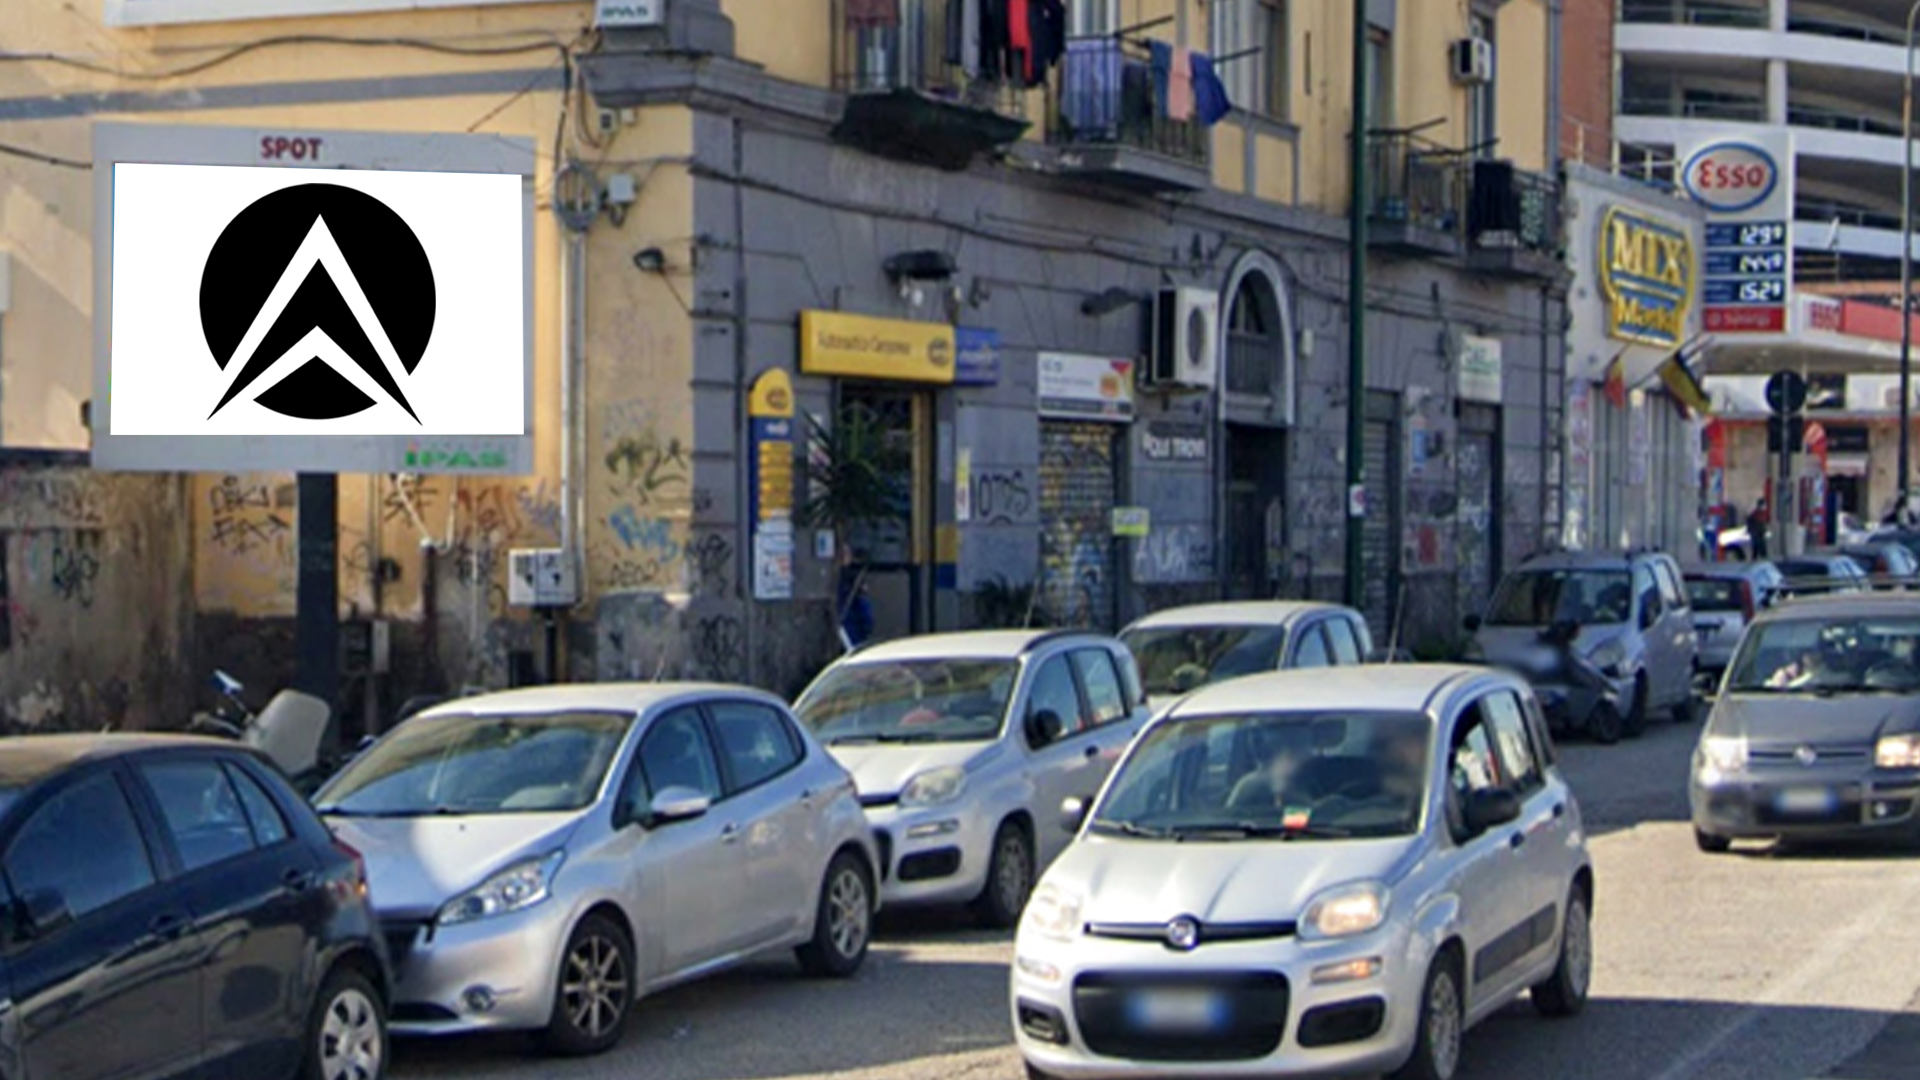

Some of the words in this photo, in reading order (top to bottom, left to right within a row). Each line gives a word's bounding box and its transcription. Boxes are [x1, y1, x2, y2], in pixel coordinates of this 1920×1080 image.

[261, 136, 322, 160] SPOT
[1699, 159, 1764, 189] Esso
[1612, 219, 1688, 286] MIX
